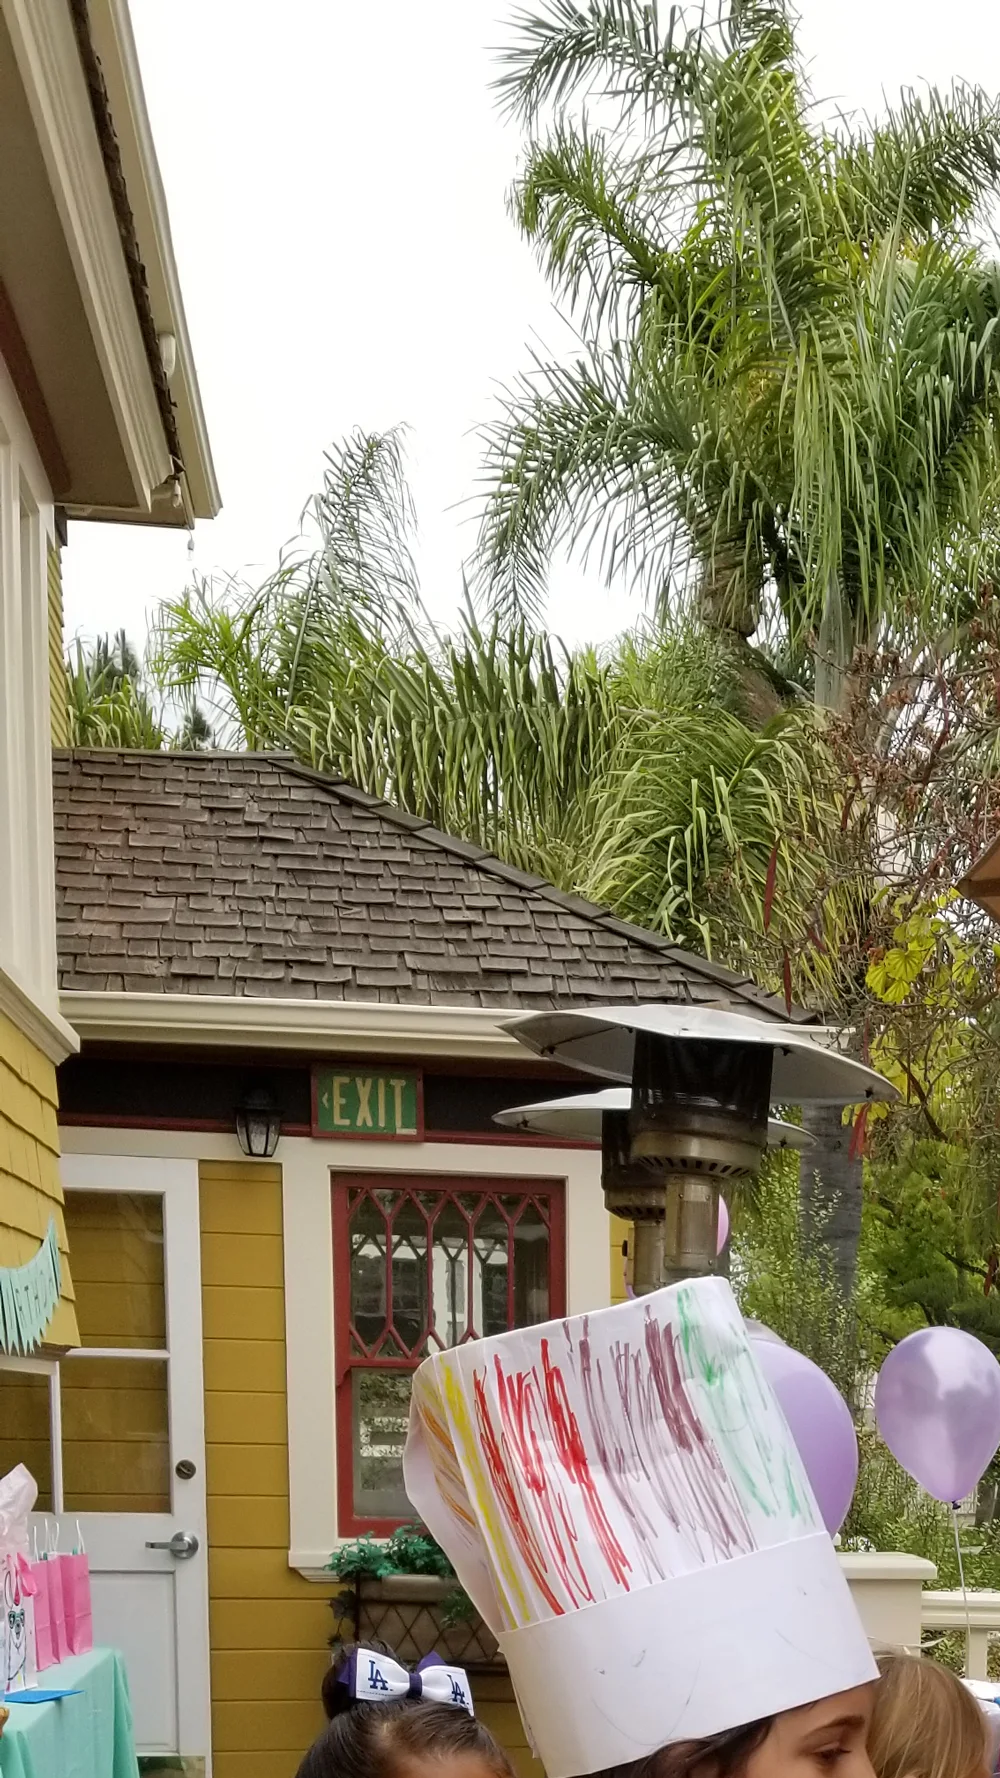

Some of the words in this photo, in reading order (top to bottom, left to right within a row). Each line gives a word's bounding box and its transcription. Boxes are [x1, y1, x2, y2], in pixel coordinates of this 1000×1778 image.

[333, 1075, 406, 1128] EXIT
[367, 1659, 389, 1691] LA
[447, 1674, 466, 1703] LA
